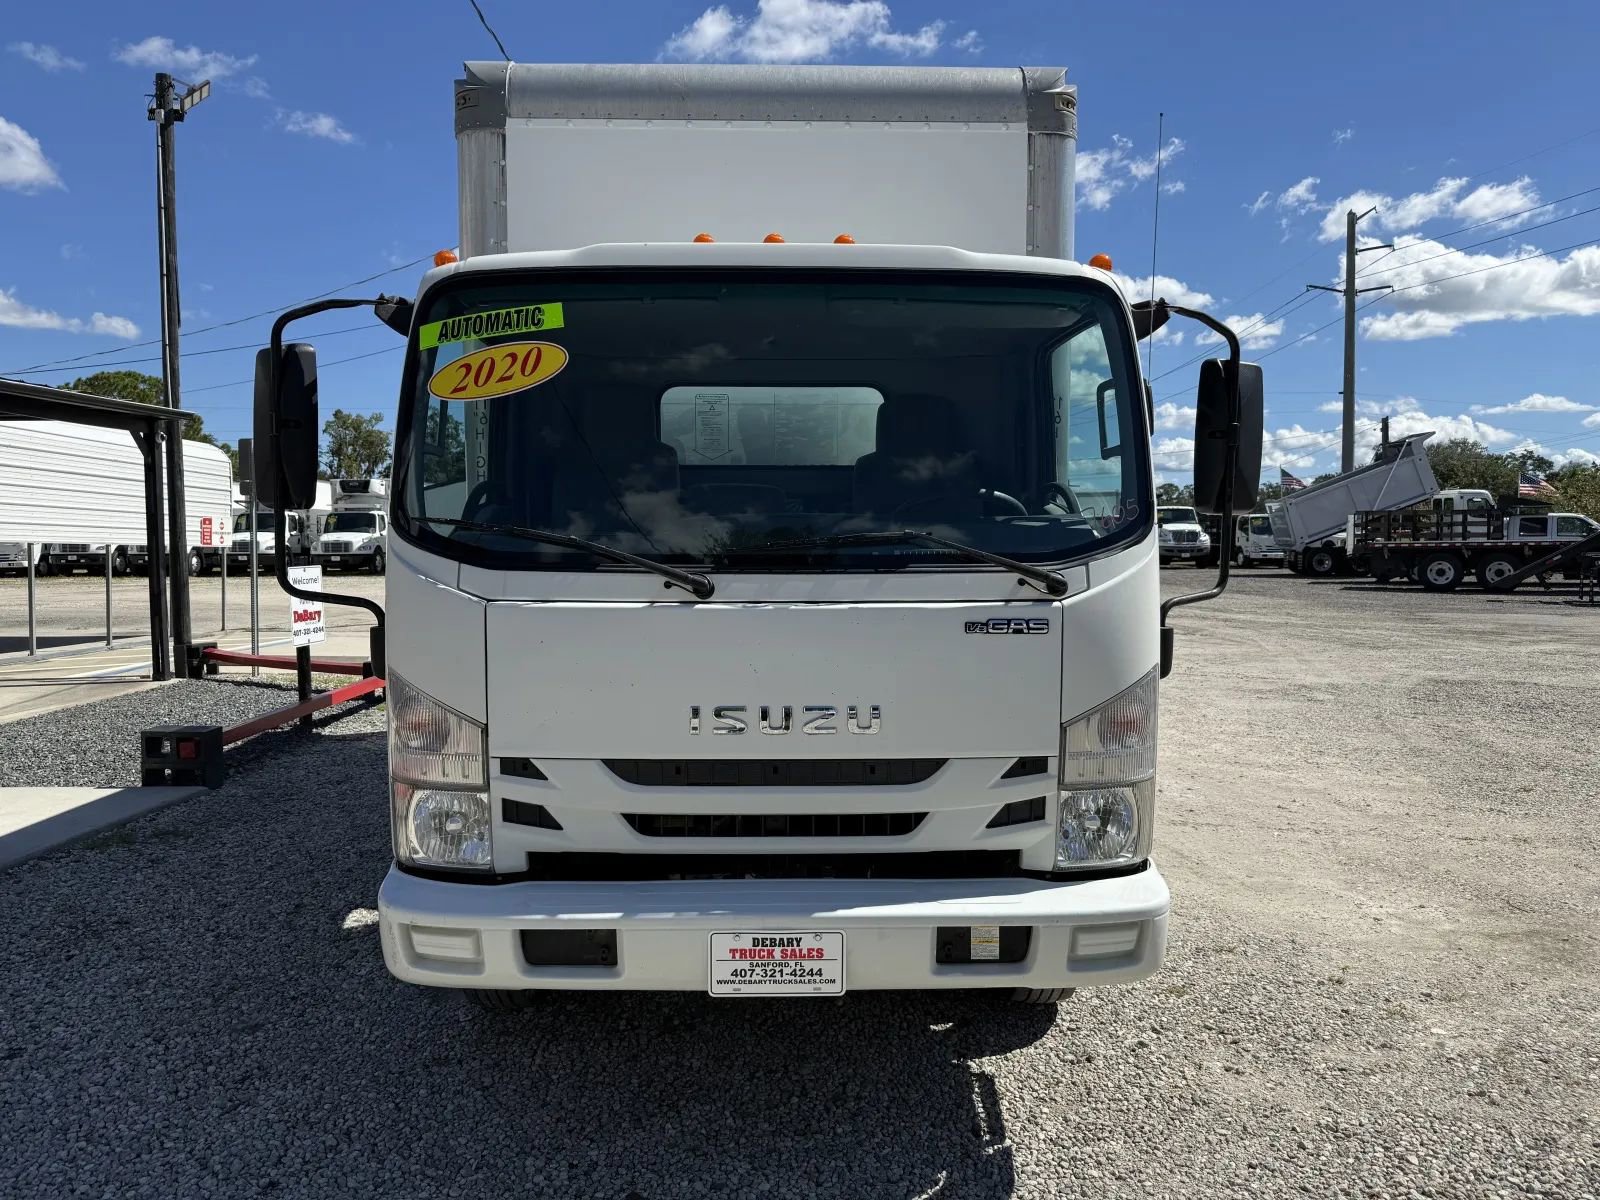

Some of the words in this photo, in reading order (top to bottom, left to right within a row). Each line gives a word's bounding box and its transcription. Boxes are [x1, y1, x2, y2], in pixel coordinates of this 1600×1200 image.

[437, 306, 545, 343] AUTOMATIC
[450, 346, 543, 394] 2020
[986, 618, 1050, 634] GAS
[689, 705, 881, 736] ISUZU
[752, 937, 803, 948] DEBARY
[728, 948, 776, 960] TRUCK
[780, 947, 825, 960] SALES
[749, 961, 792, 969] SANFORD,
[730, 967, 823, 978] 407-321-4244
